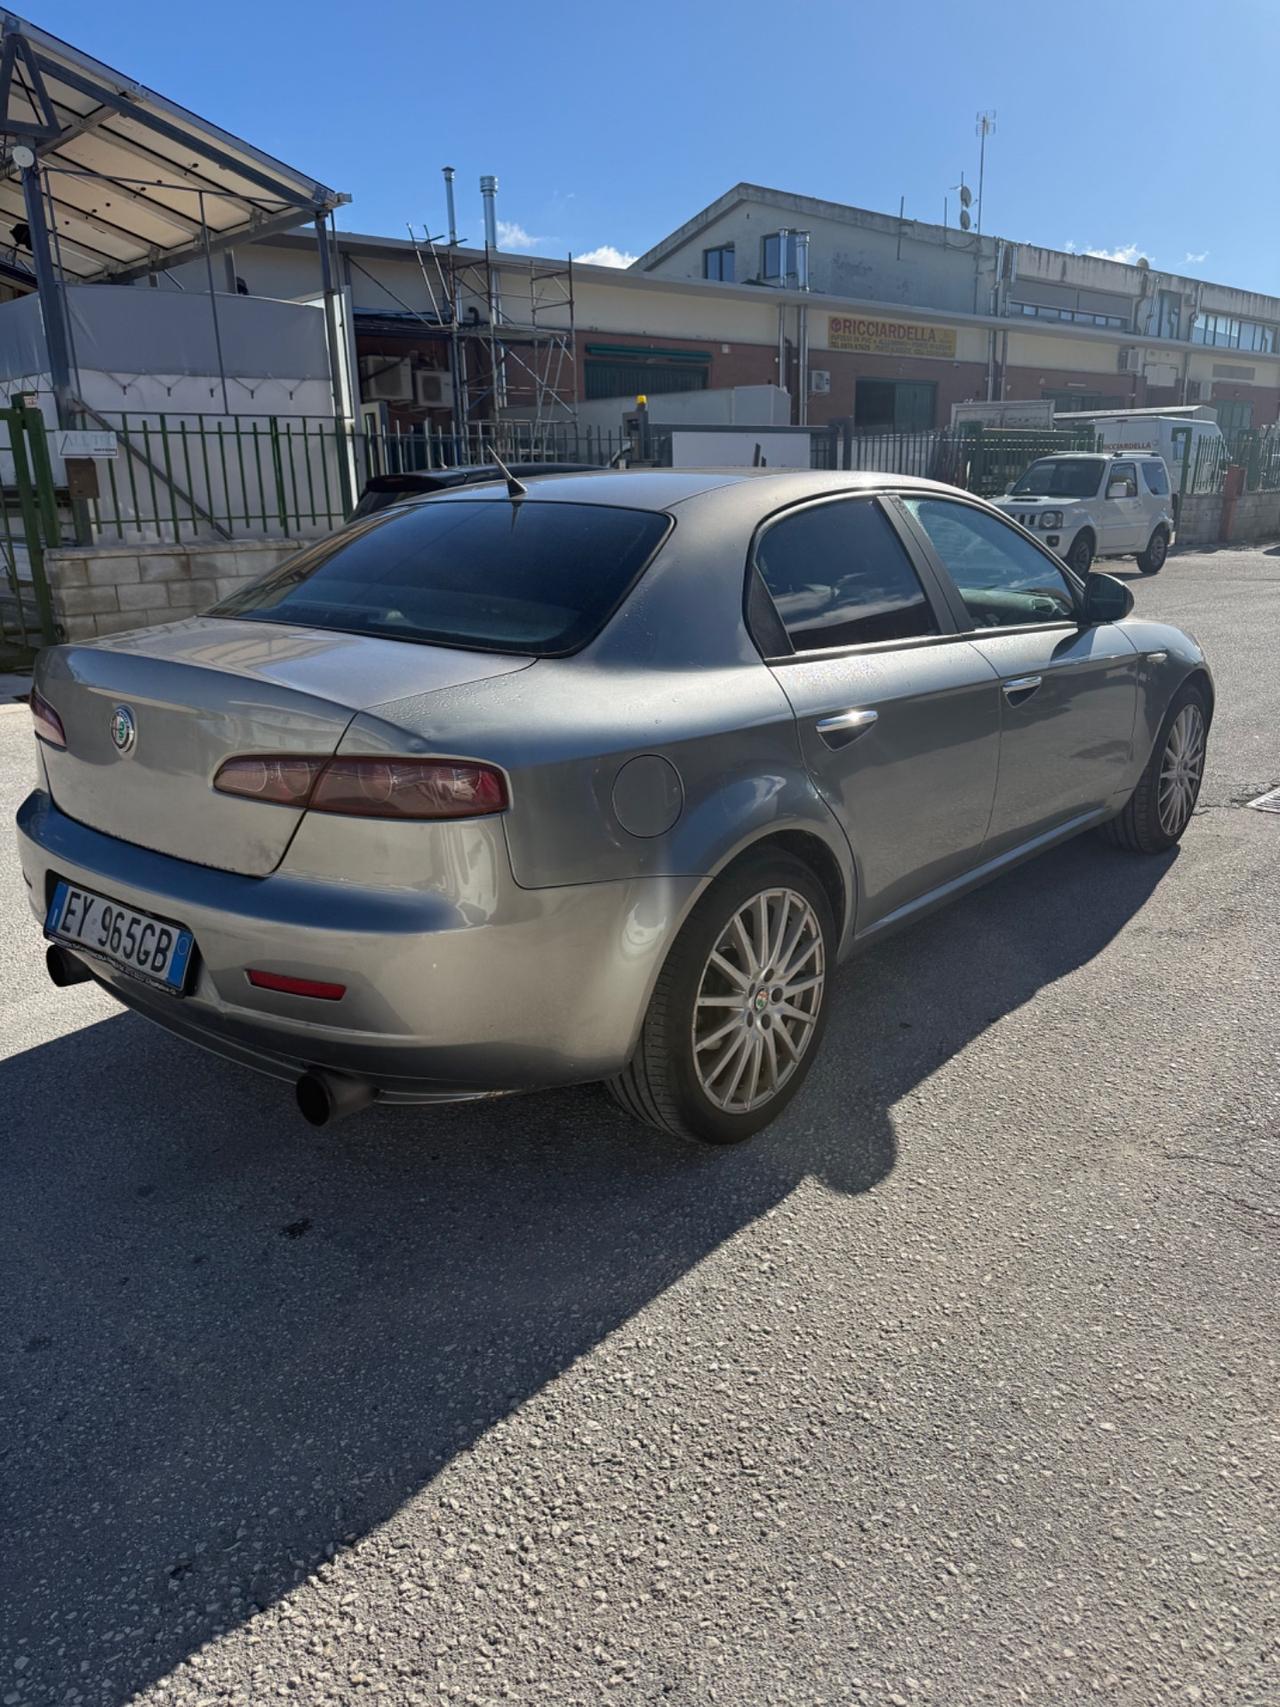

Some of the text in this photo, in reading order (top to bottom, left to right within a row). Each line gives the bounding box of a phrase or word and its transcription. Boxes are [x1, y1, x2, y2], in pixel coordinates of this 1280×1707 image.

[842, 318, 937, 343] RICCIARDELLA
[60, 890, 95, 938] EY
[97, 905, 173, 974] 965GB
